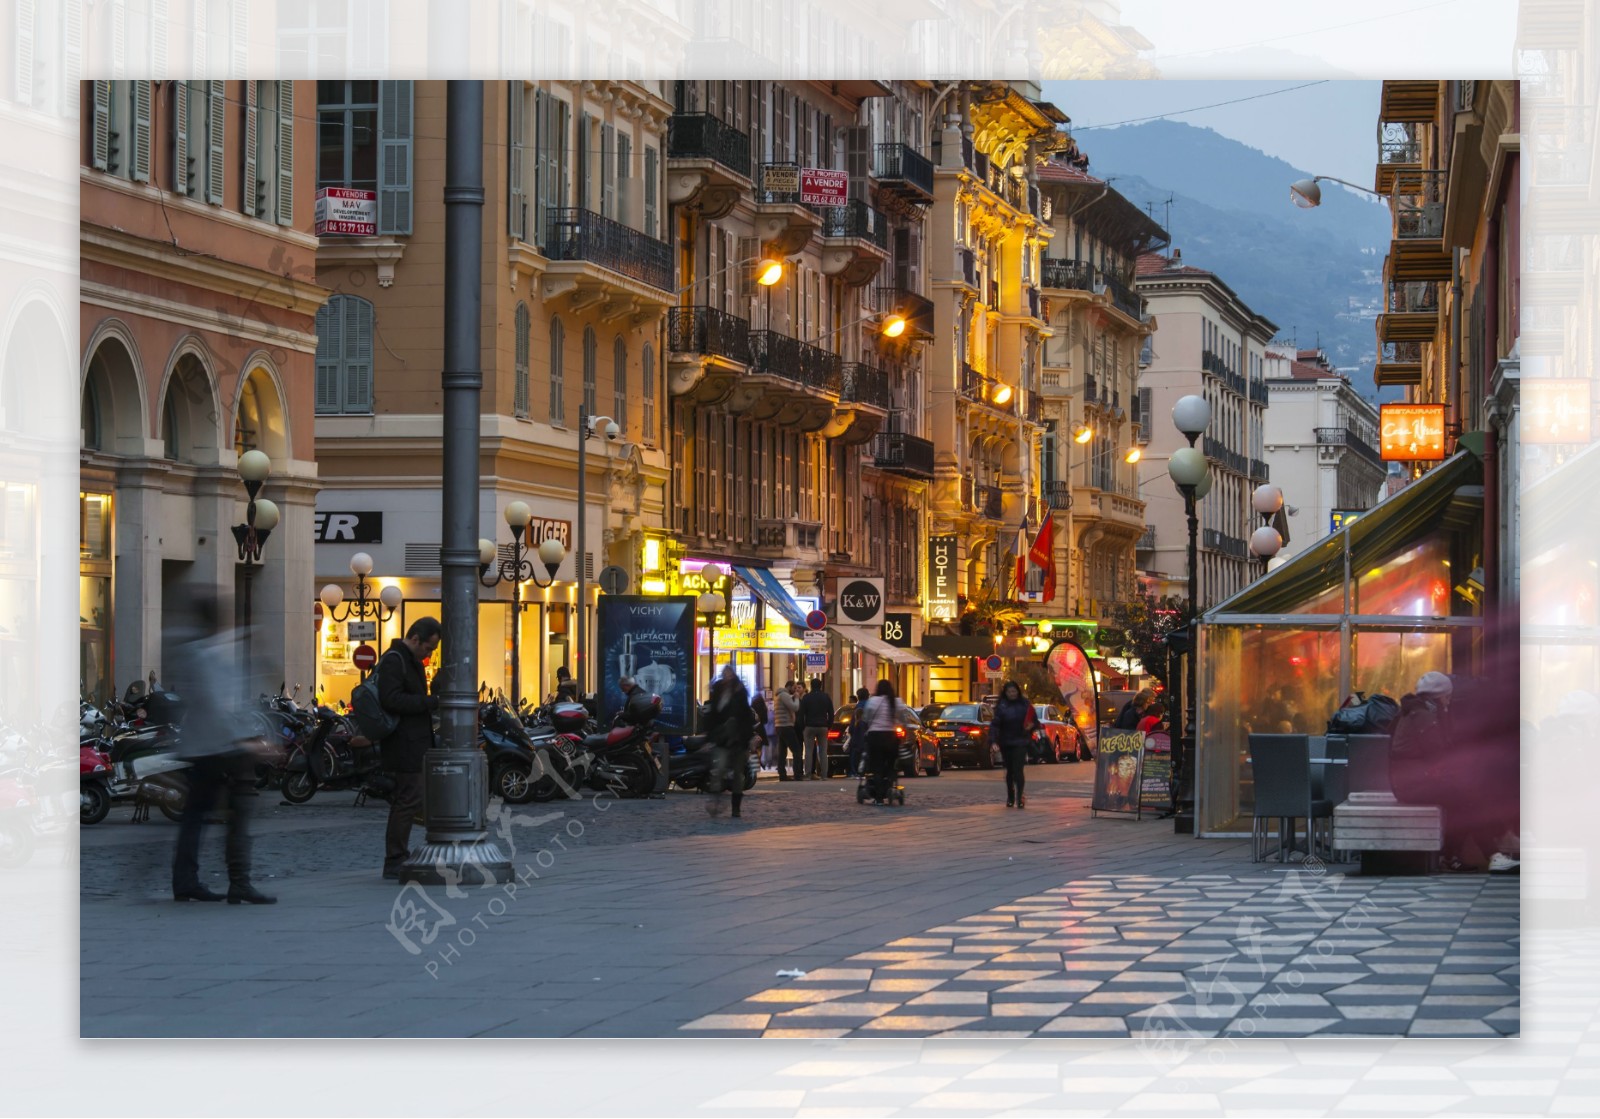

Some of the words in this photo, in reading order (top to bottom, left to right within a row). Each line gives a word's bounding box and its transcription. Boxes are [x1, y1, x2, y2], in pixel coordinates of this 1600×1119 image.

[814, 178, 844, 188] VENDRE
[342, 190, 368, 199] VENDRE
[329, 222, 337, 231] 06
[339, 222, 346, 231] 12
[347, 224, 356, 232] 77
[357, 224, 365, 232] 13
[532, 519, 568, 547] TIGER
[935, 545, 948, 598] HOTEL
[629, 606, 664, 615] VICHY
[1100, 732, 1143, 753] KEBAB
